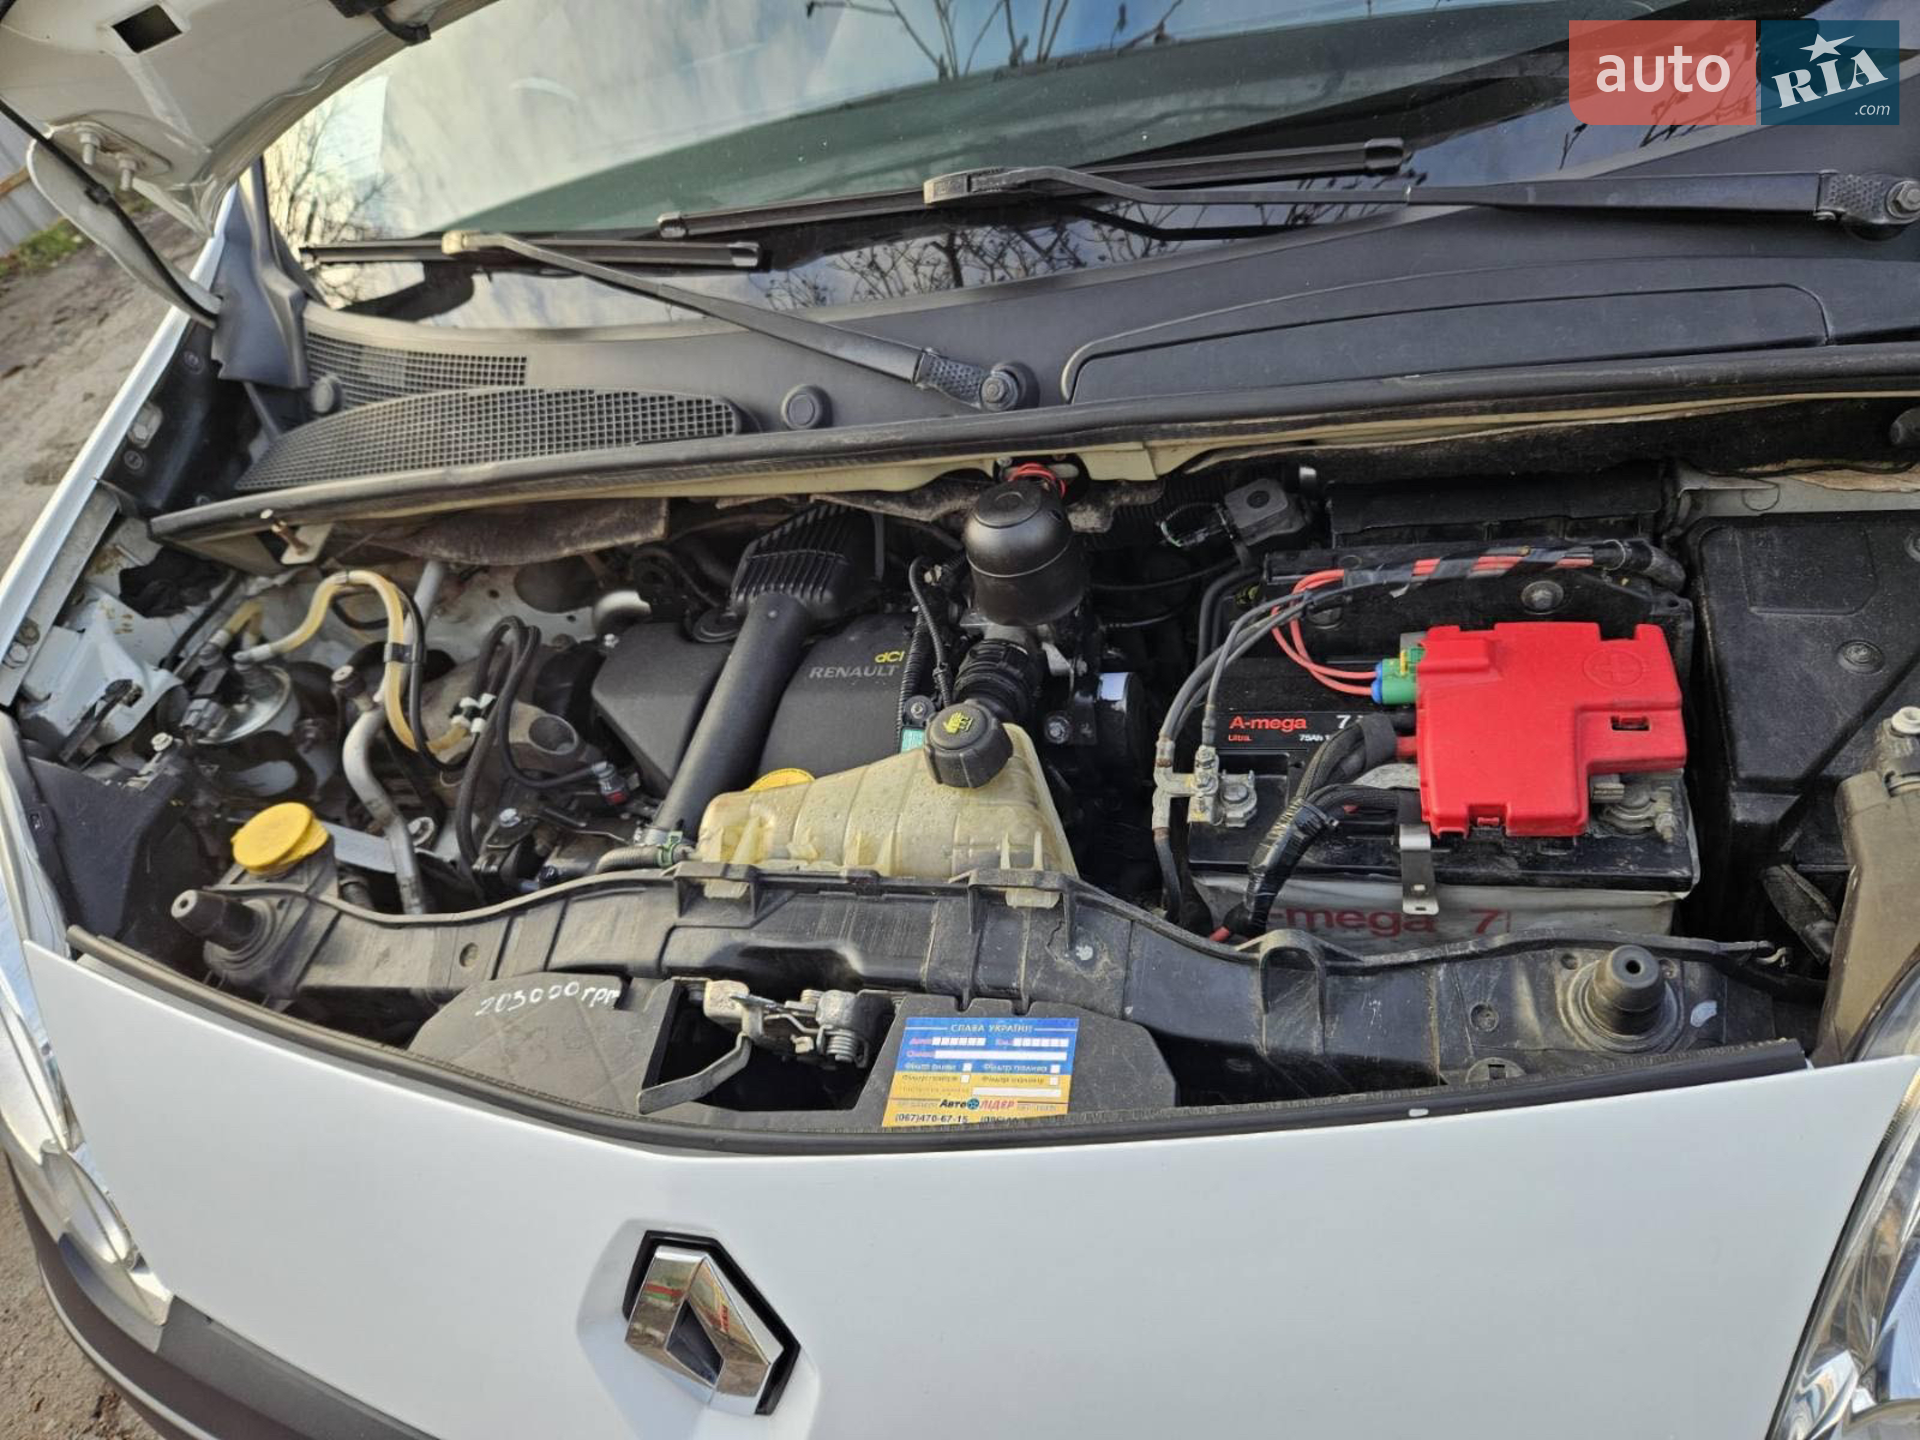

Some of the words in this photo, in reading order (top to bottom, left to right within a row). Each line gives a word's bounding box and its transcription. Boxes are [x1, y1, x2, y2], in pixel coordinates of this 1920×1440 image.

[809, 665, 899, 679] RENAULT
[1229, 715, 1307, 732] A-mega
[940, 1099, 967, 1108] Авто
